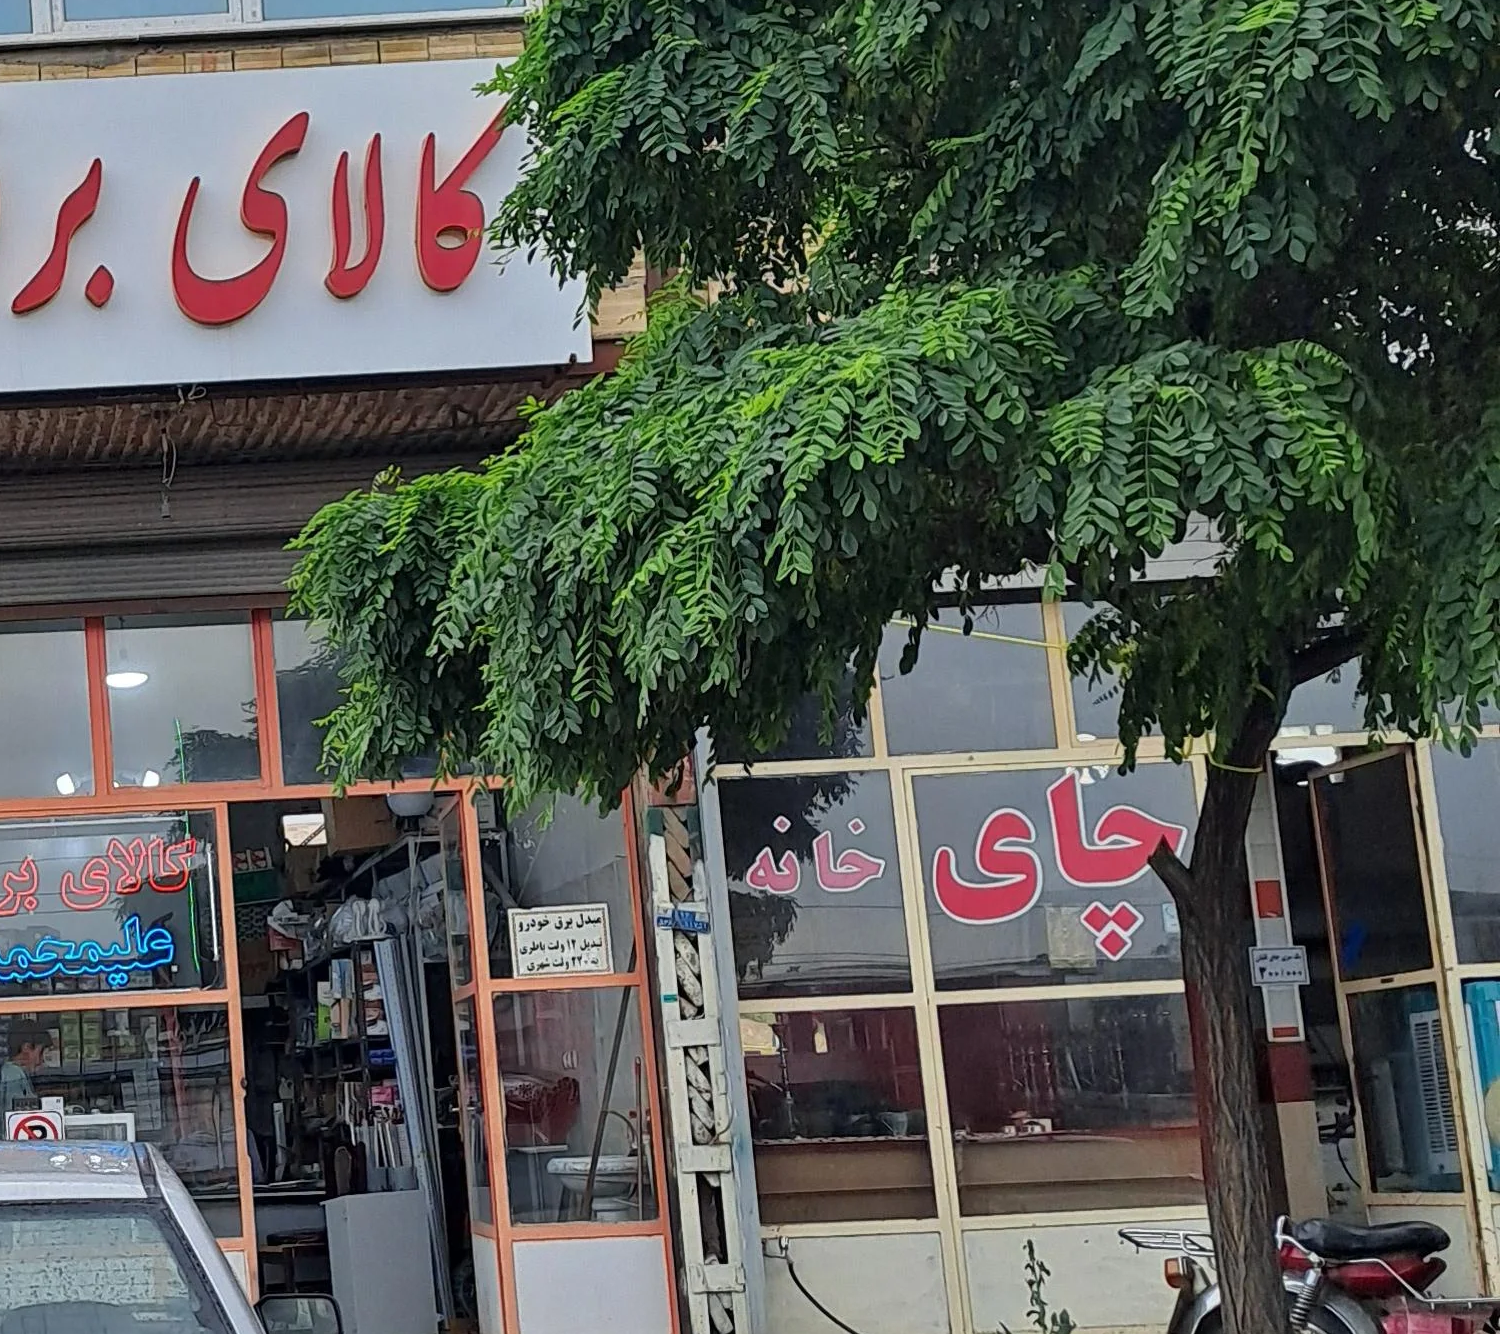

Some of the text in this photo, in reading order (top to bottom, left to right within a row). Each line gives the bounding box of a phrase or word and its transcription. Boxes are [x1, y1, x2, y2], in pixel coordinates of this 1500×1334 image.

[171, 99, 513, 327] کالای
[60, 835, 198, 911] کالای
[746, 770, 1188, 961] چای خانه
[518, 915, 550, 932] خودرو
[554, 915, 574, 930] برق
[547, 939, 565, 953] ولت
[552, 956, 570, 970] ولت
